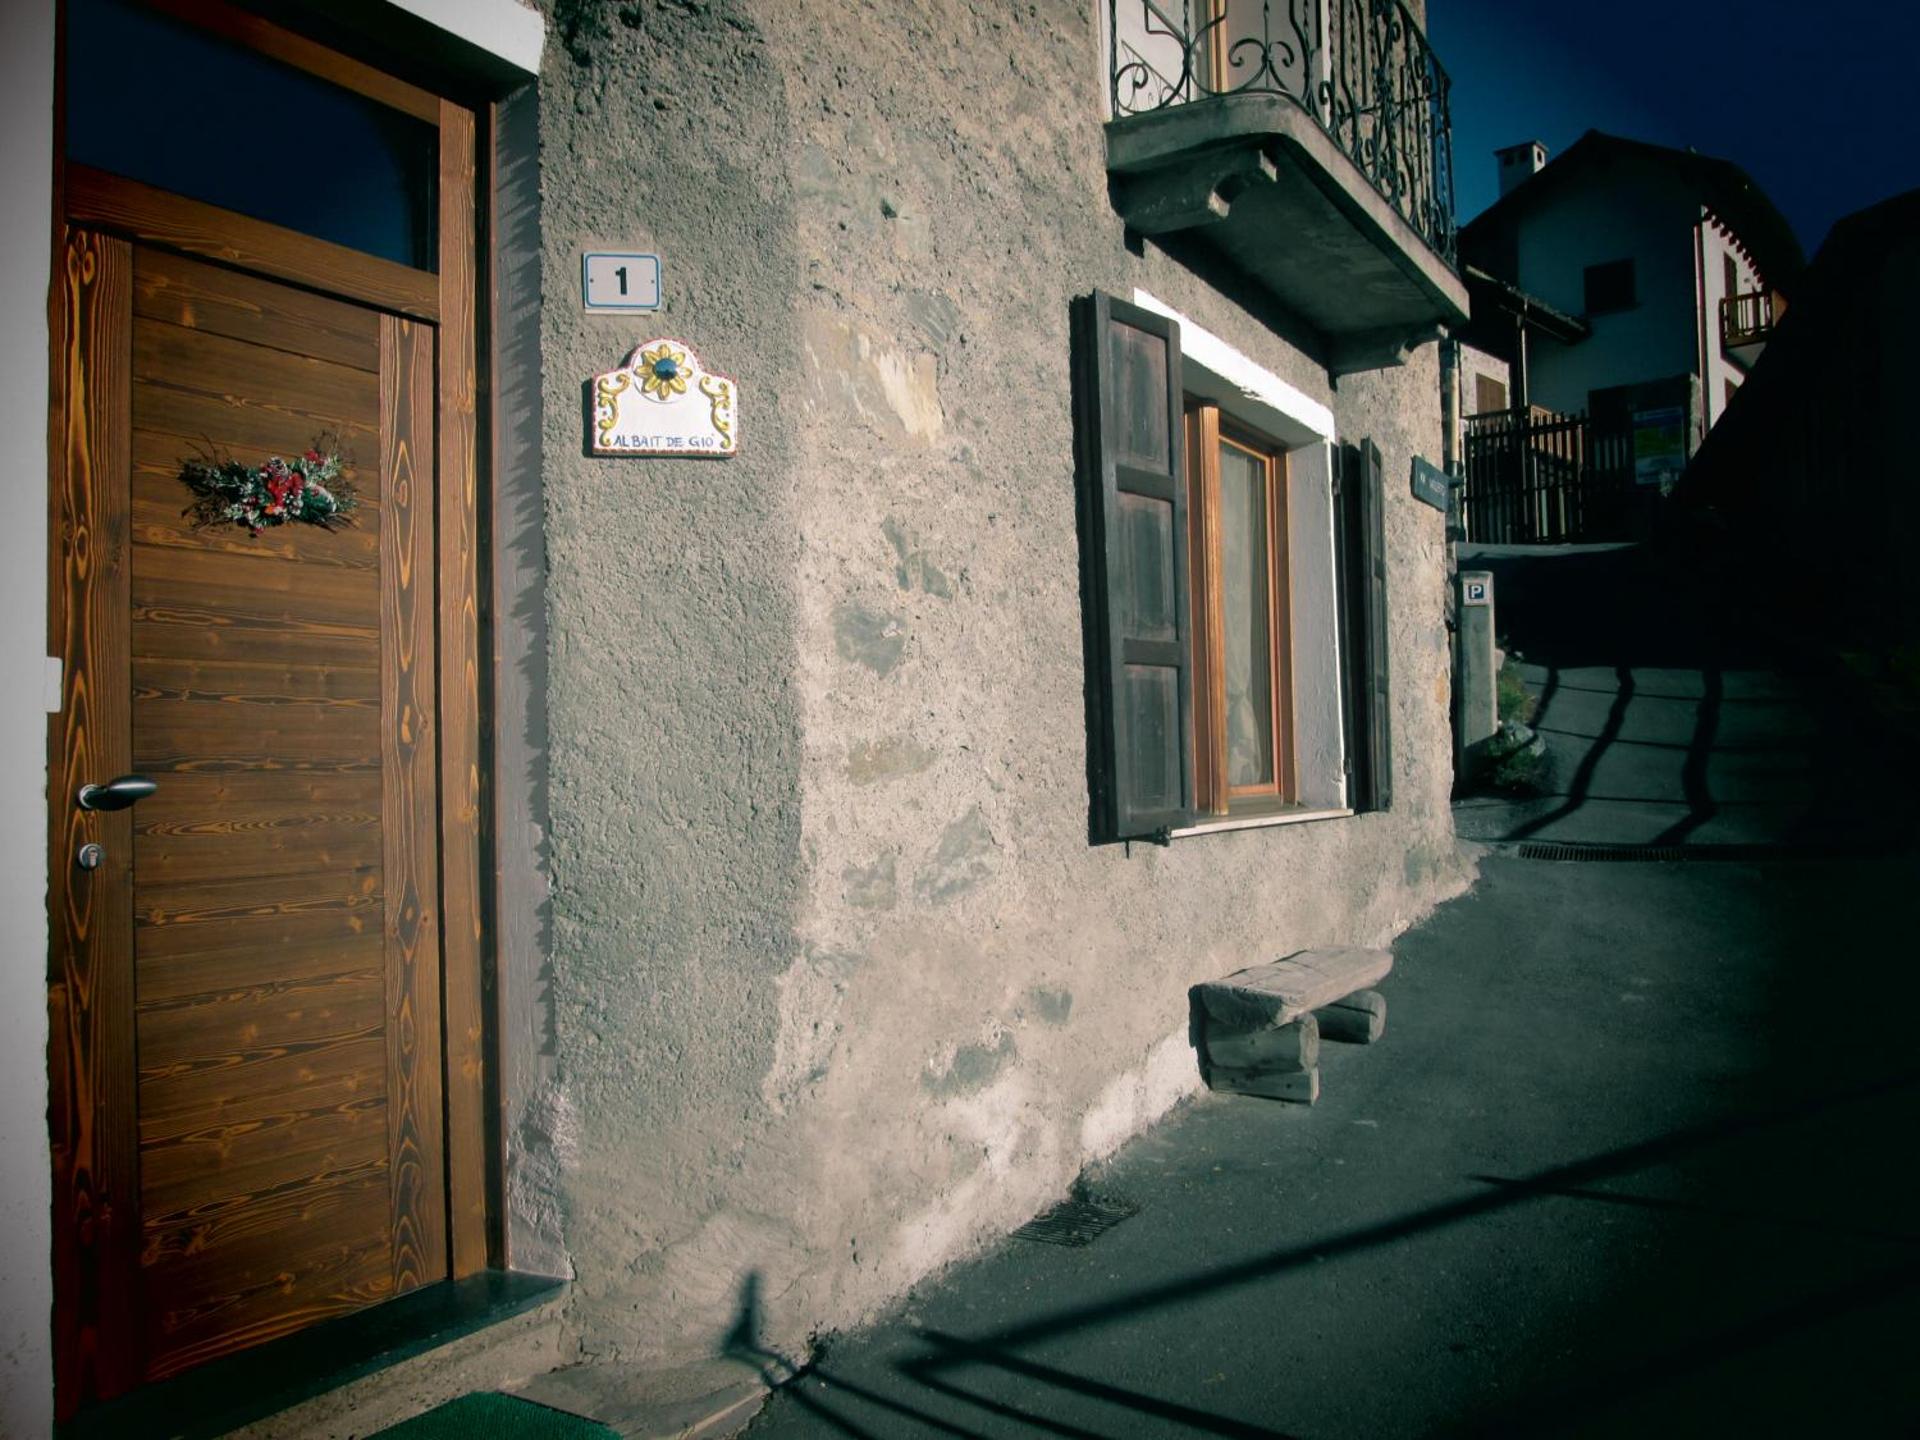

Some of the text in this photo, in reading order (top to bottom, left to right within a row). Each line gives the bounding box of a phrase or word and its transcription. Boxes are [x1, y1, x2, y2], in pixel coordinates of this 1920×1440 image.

[615, 266, 628, 296] 1
[613, 435, 629, 448] AL
[631, 435, 663, 448] BAIT
[666, 436, 683, 448] DE
[1471, 585, 1482, 598] P
